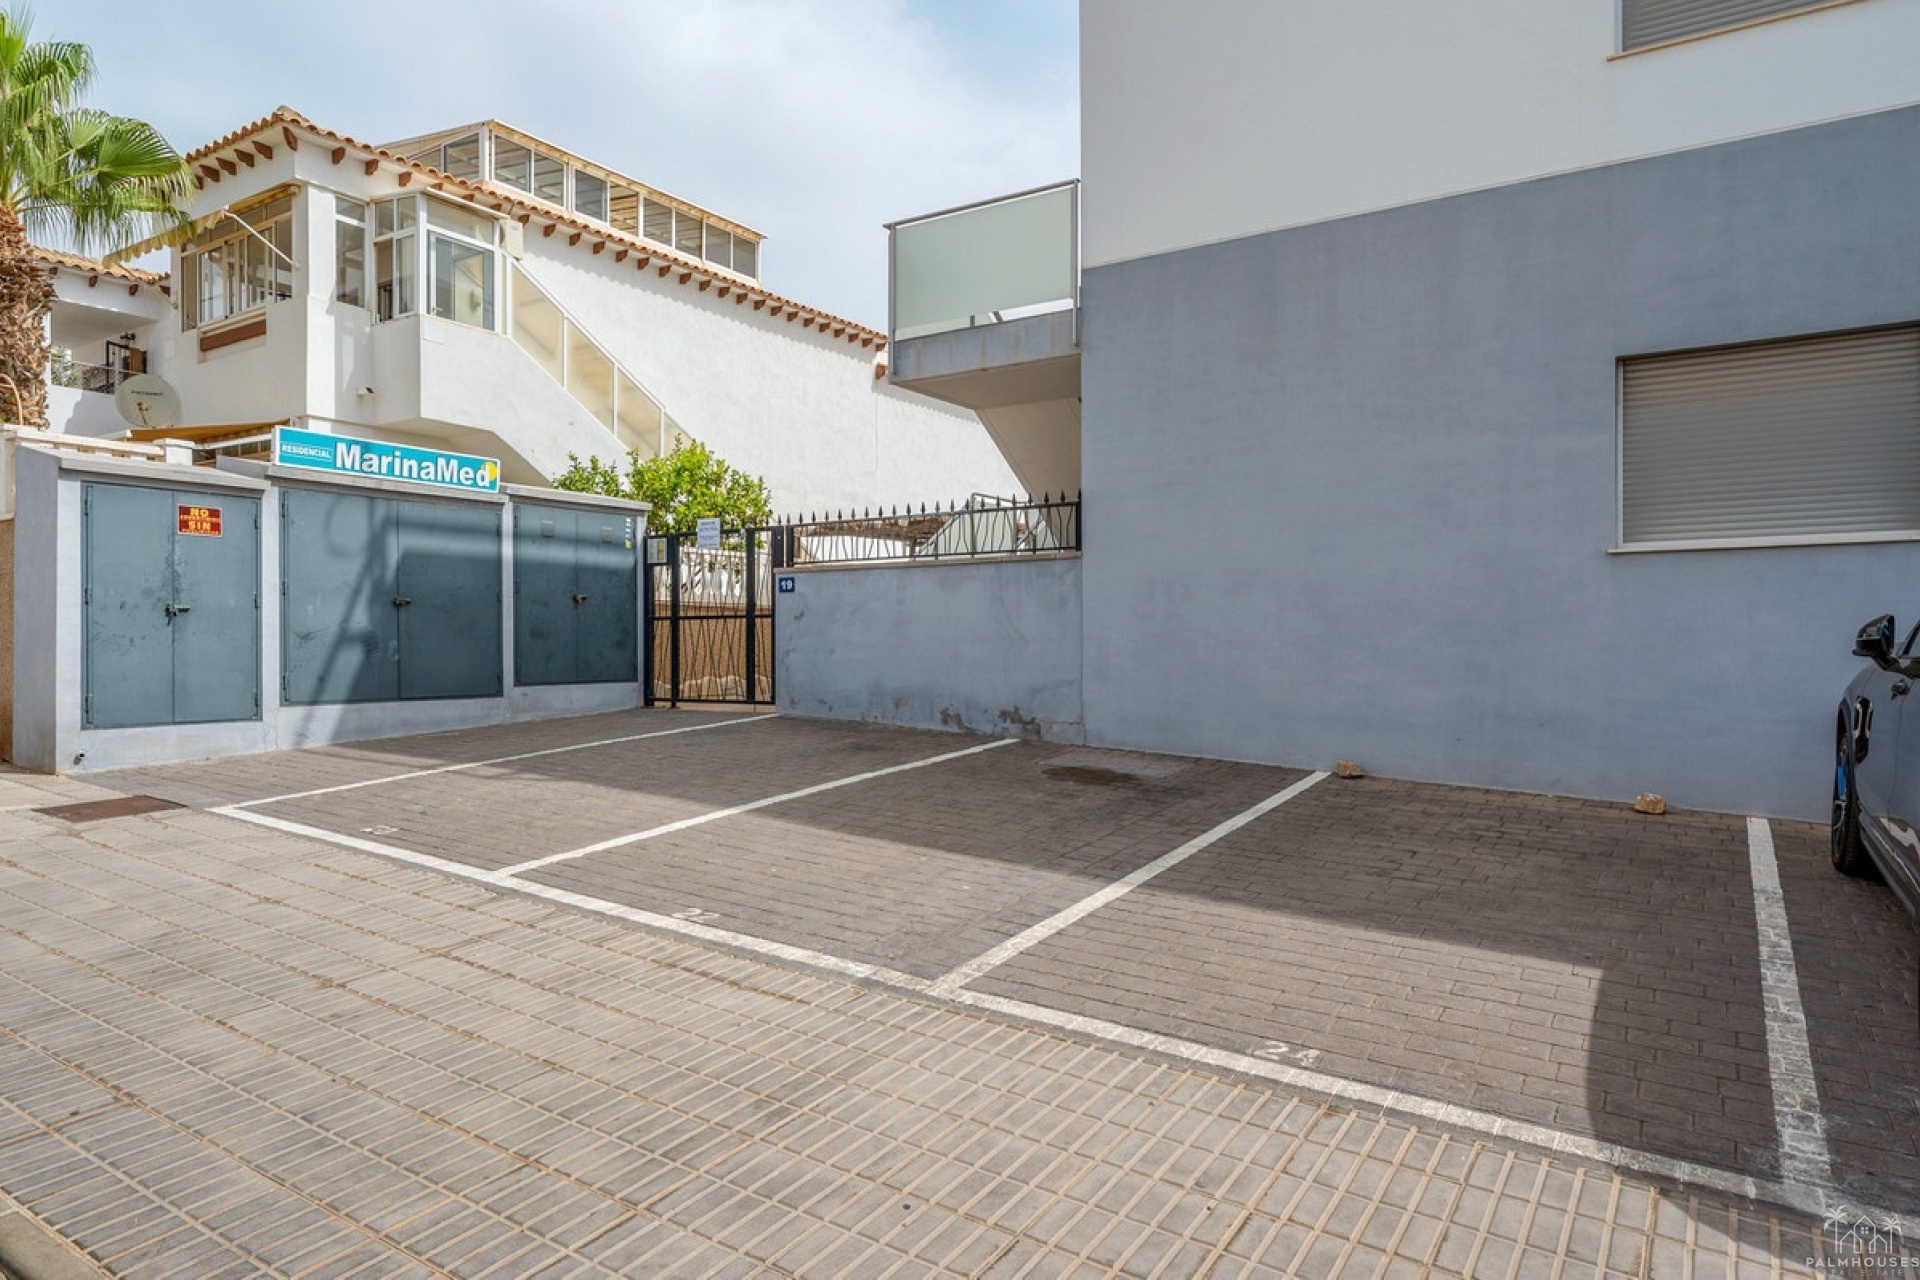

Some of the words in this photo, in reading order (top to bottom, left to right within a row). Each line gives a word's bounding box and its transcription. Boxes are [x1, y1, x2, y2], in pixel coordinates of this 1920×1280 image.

[281, 443, 331, 458] RESIDENCIAL
[335, 441, 490, 487] MarinaMed
[190, 507, 209, 517] NO
[188, 520, 211, 531] SIN
[780, 580, 793, 590] 19
